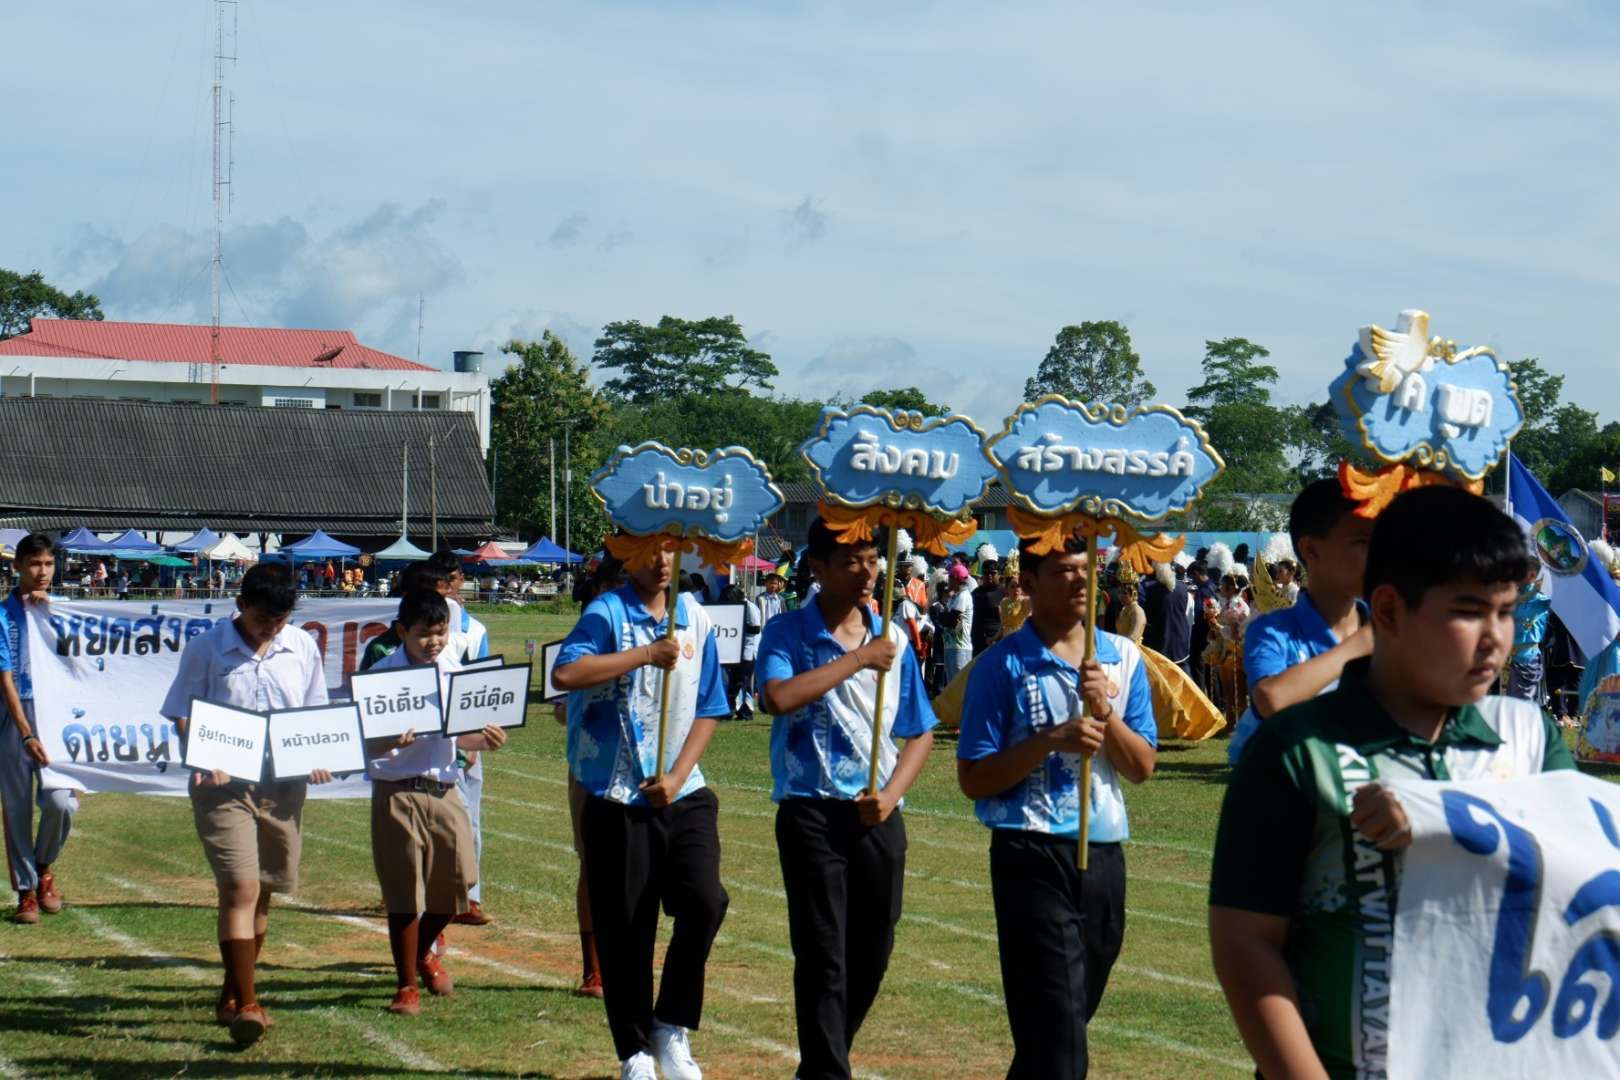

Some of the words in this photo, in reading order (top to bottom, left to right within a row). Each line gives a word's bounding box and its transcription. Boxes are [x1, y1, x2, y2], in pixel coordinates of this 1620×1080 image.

[850, 429, 960, 480] สังคม
[1017, 432, 1196, 477] สร้างสรรค์
[643, 471, 734, 523] น่าอยู่
[363, 686, 426, 715] ไอ้เตี้ย
[460, 684, 515, 711] อีนี่ตุ๊ด
[282, 731, 350, 748] หน้าปลวก
